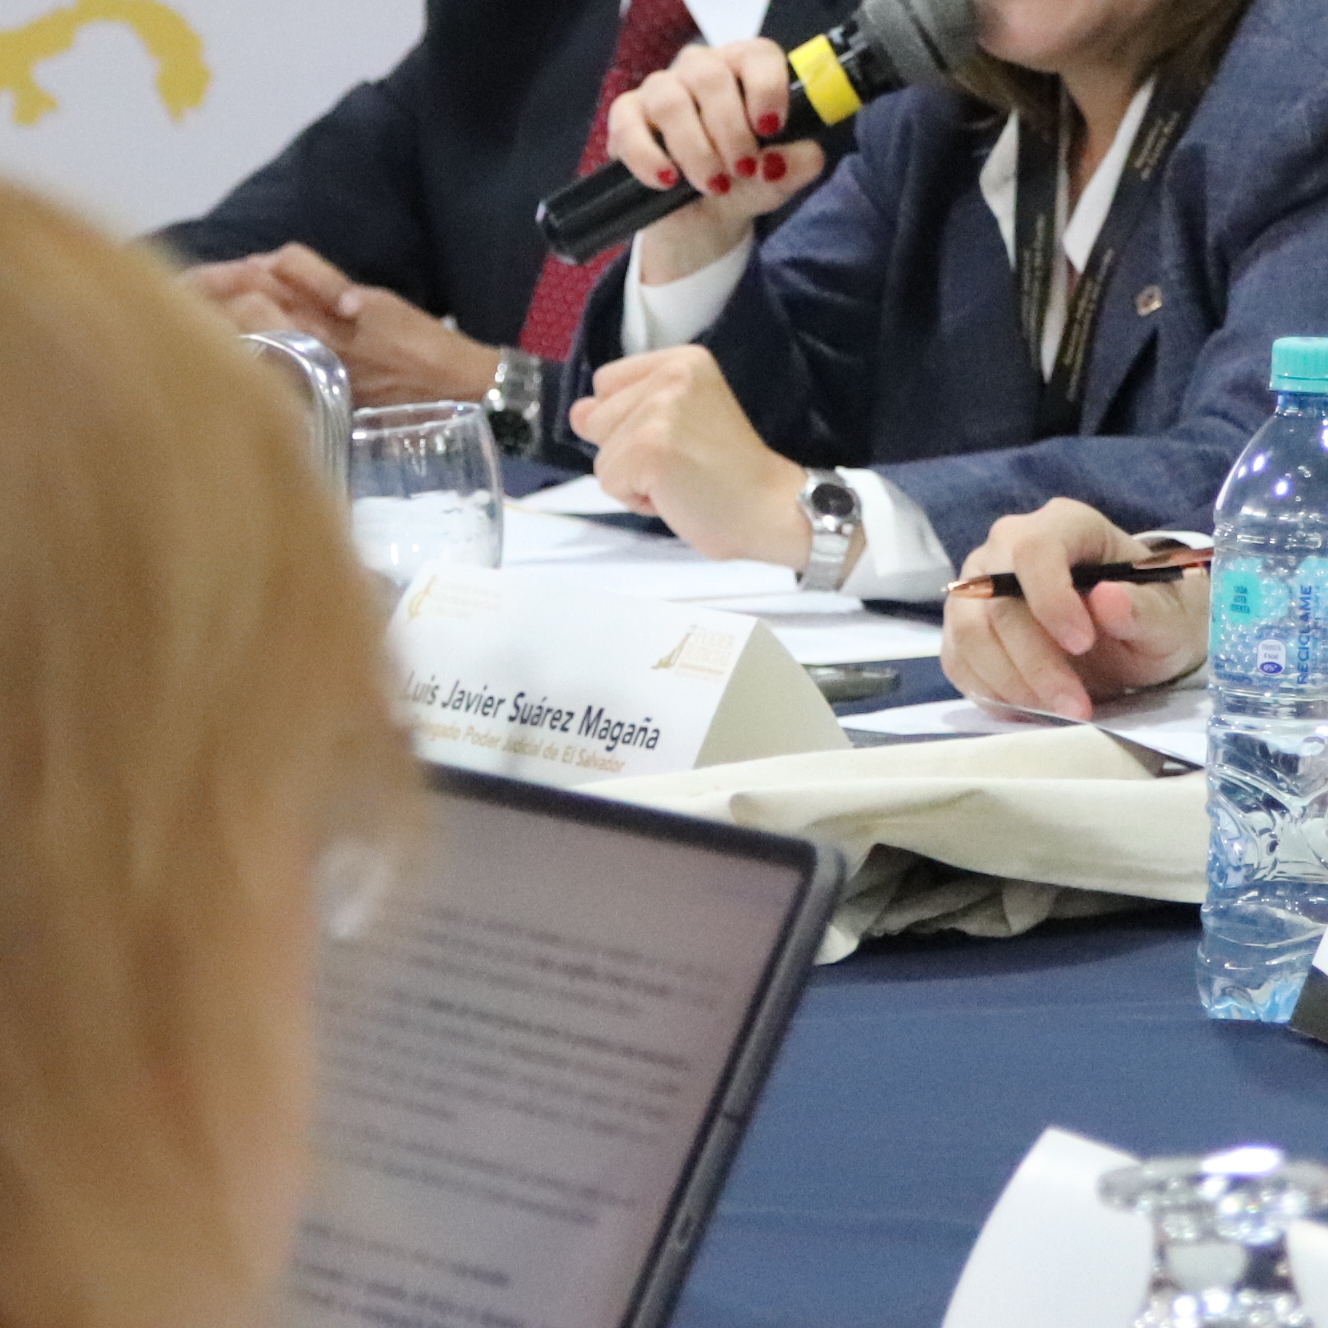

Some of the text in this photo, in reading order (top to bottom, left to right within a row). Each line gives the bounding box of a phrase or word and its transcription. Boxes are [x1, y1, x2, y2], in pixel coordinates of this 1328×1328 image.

[1297, 584, 1312, 685] RECICLAME
[404, 670, 661, 752] Luis Javier Suárez Magaña
